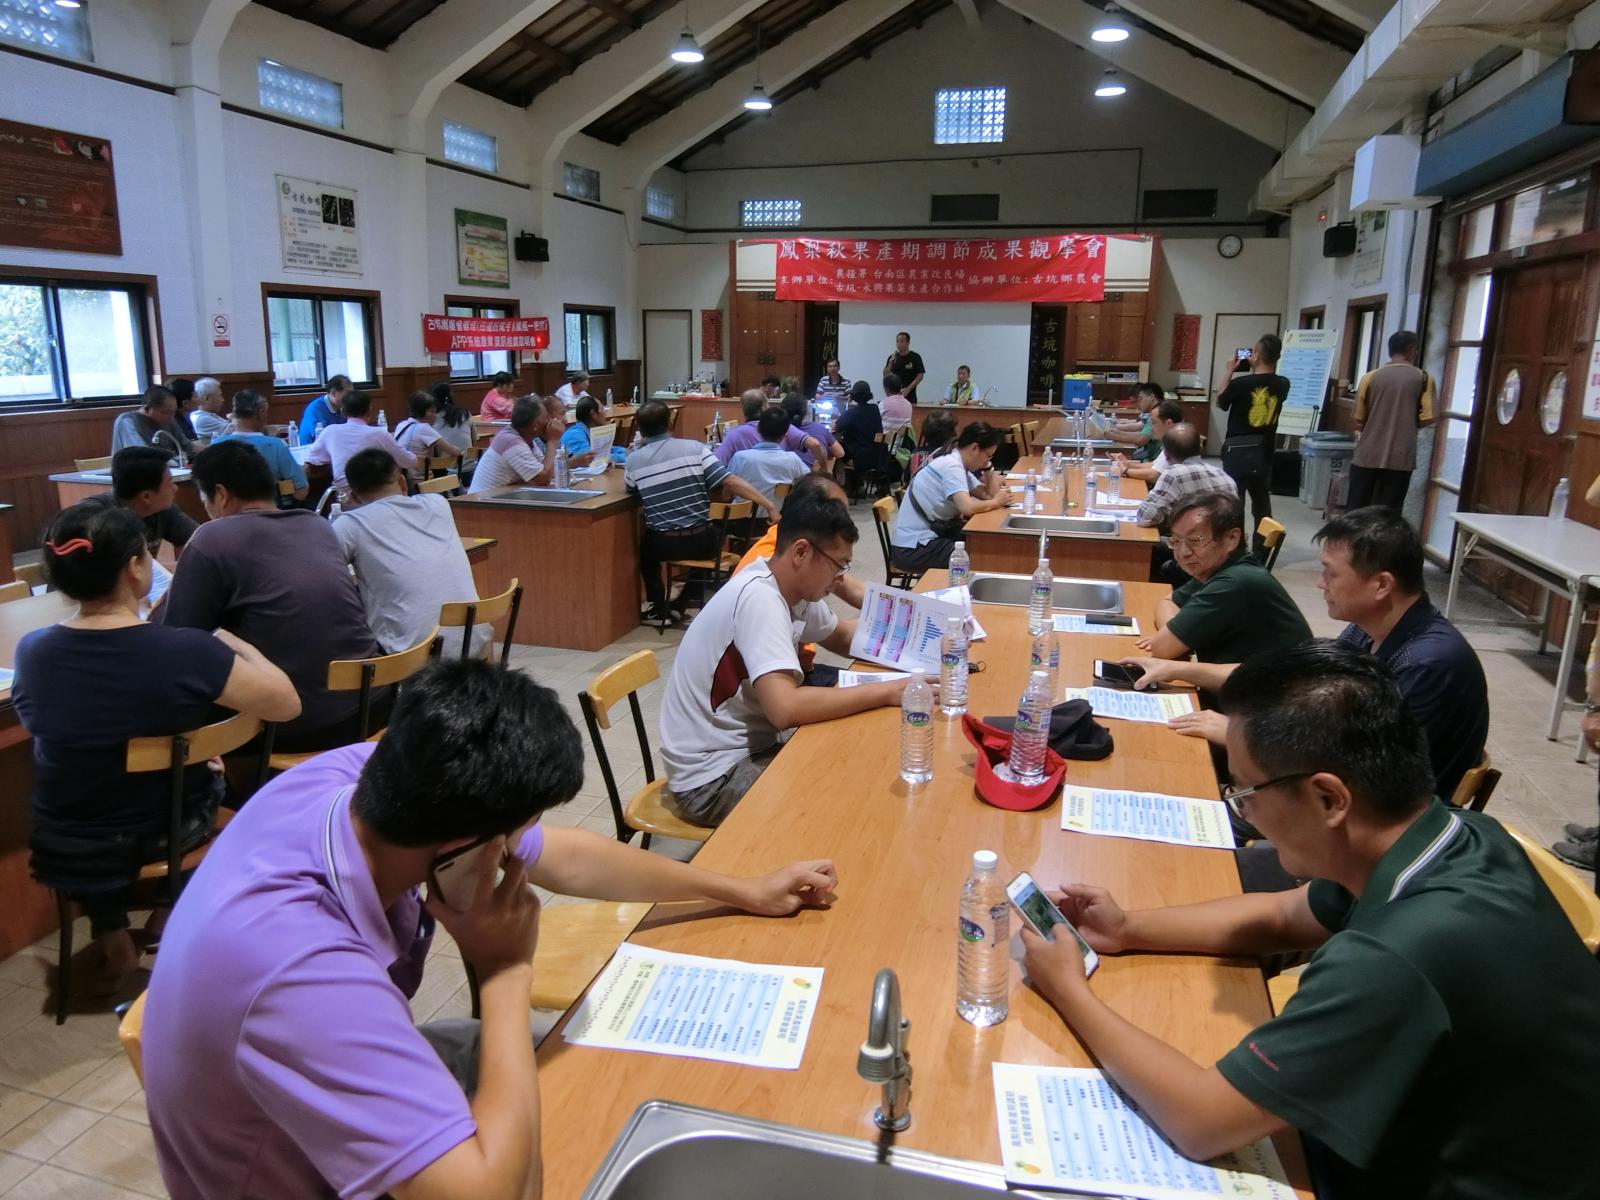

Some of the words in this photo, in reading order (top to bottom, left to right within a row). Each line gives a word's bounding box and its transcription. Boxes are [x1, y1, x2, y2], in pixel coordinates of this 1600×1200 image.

[780, 237, 1104, 261] 鳳梨秋果產期調節成果觀摩會
[1041, 317, 1059, 389] 古坑咖啡
